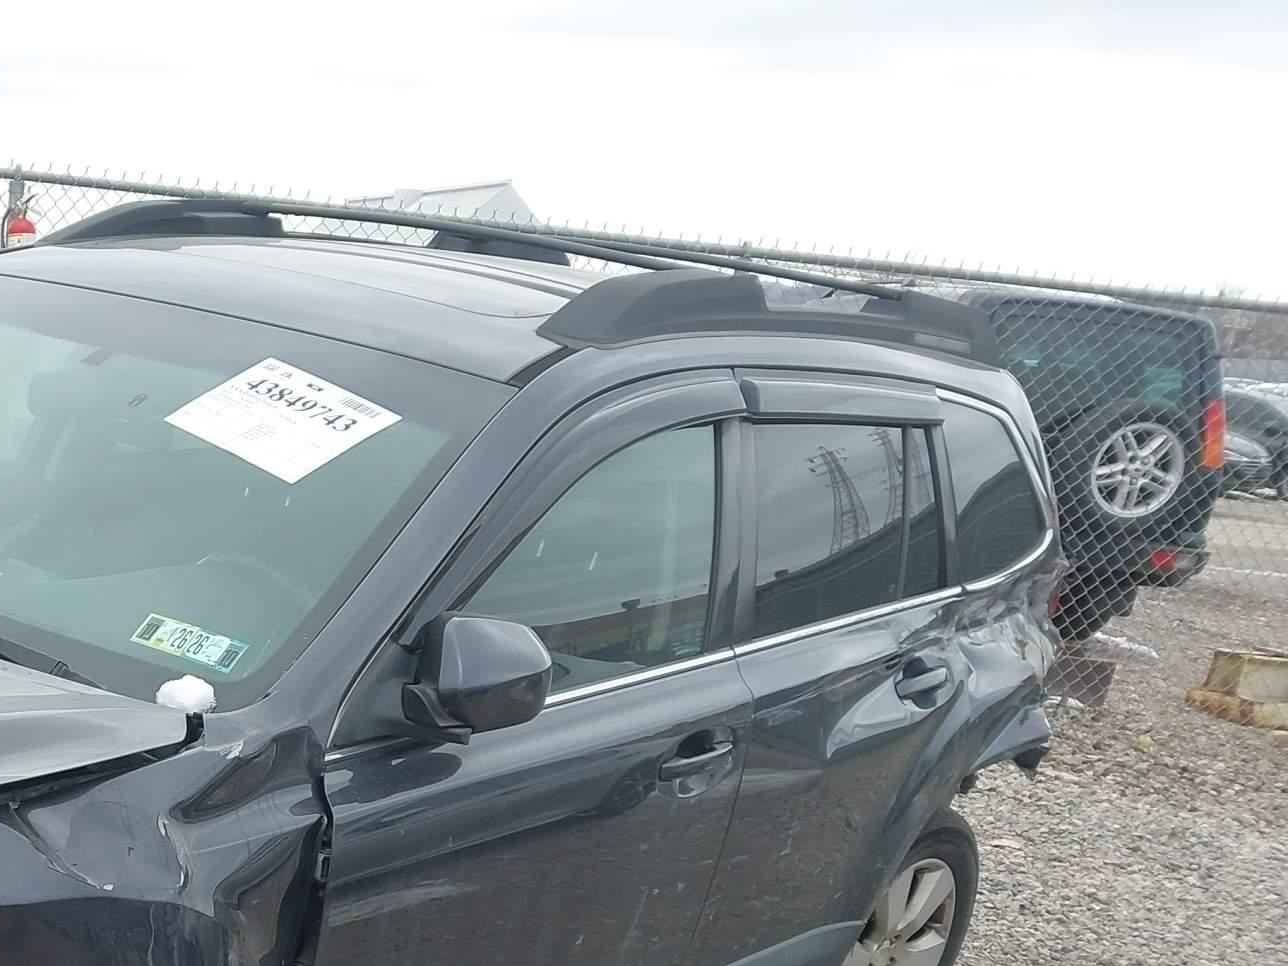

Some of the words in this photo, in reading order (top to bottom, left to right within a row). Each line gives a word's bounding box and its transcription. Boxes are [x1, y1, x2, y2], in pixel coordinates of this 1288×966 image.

[247, 378, 358, 433] 43849743
[170, 628, 193, 650] 26
[186, 633, 210, 656] 26
